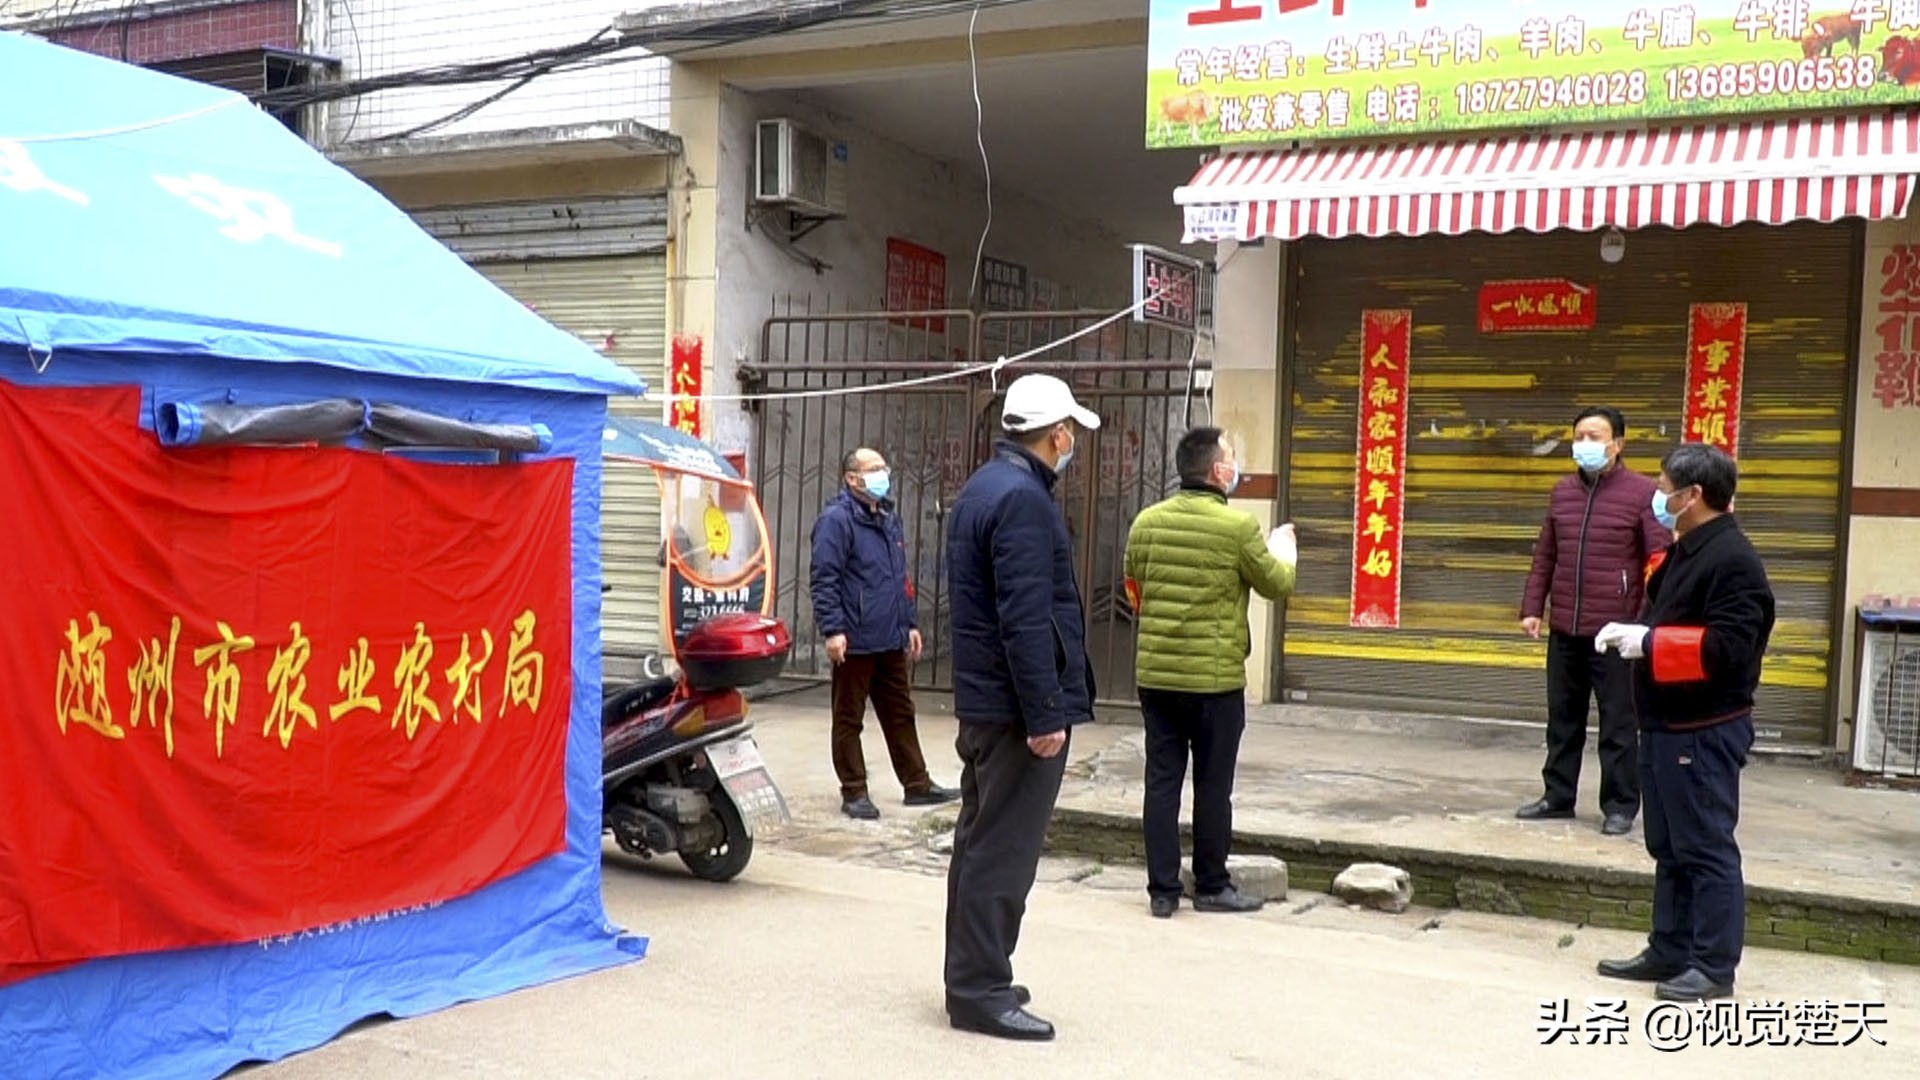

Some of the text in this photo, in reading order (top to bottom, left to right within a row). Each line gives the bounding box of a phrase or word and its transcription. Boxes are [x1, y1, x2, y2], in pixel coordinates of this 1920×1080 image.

[1218, 88, 1350, 133] 批发兼零售
[1455, 70, 1646, 115] 18727946028
[1664, 54, 1876, 101] 13685906538
[55, 609, 545, 759] 随州市农业农村局
